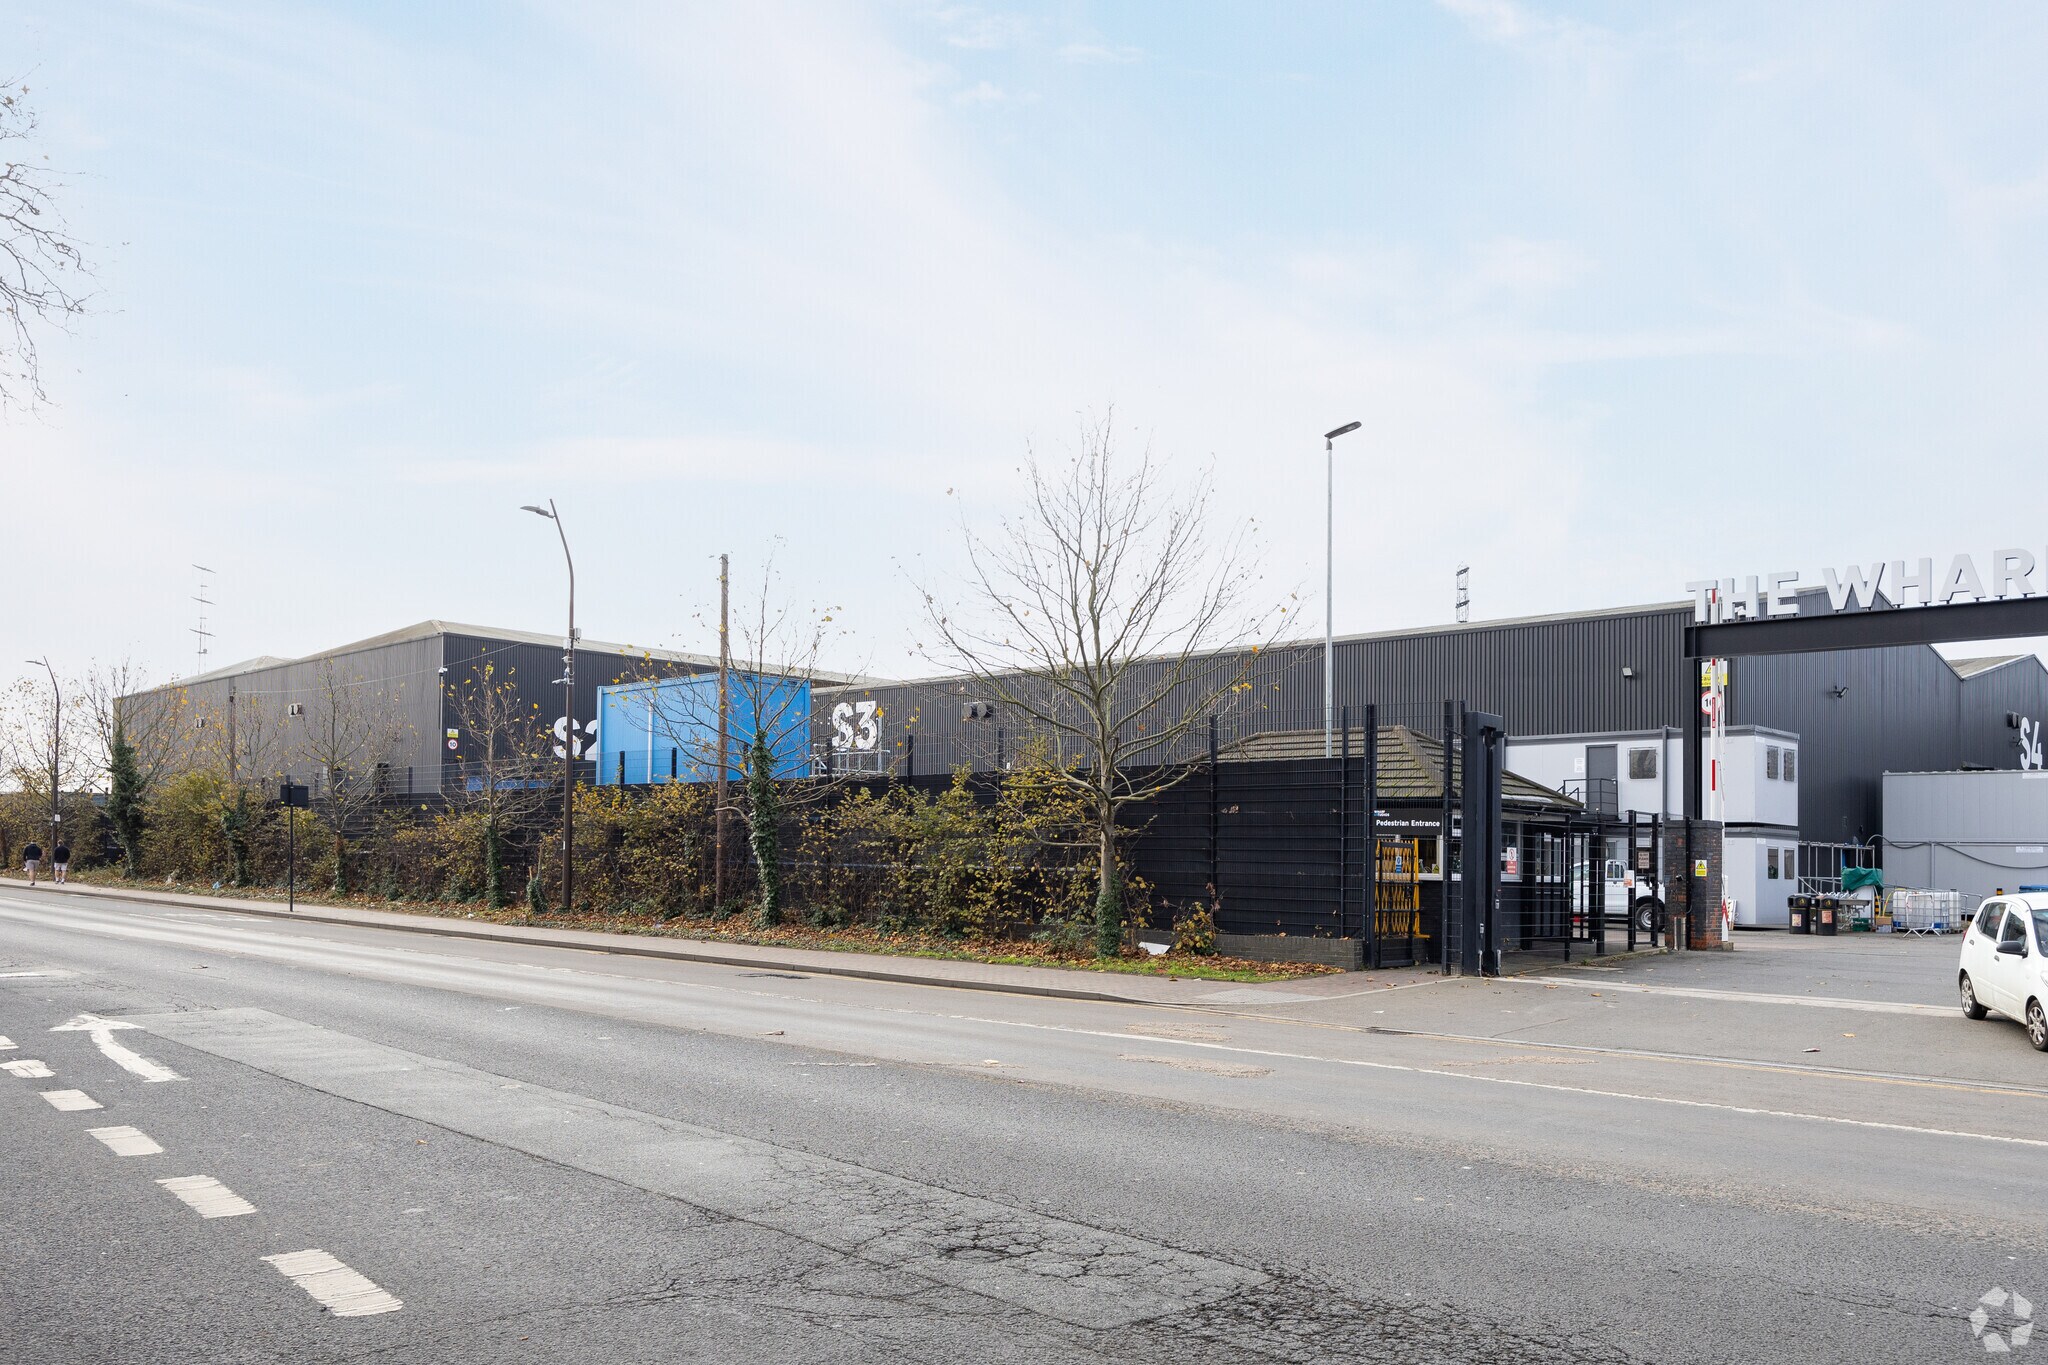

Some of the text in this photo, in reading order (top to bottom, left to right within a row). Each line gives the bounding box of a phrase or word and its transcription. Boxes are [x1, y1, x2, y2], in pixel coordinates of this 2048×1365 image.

[1686, 545, 2048, 622] THE WHAR
[832, 700, 878, 751] S3
[2020, 716, 2043, 770] S4
